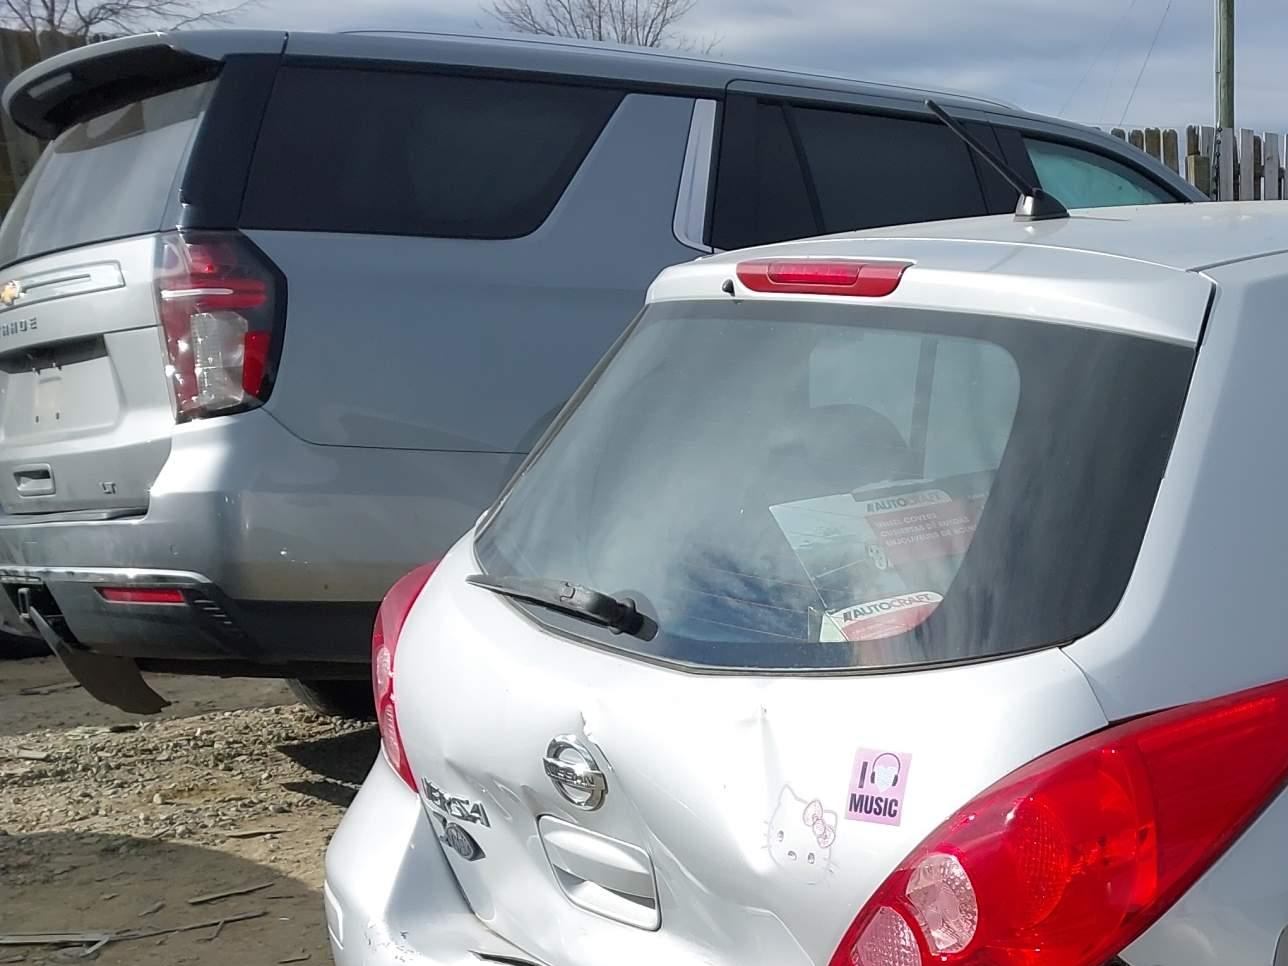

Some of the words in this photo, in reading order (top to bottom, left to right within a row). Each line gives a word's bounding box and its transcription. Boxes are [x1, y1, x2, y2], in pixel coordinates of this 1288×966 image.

[854, 593, 931, 619] AUTOCRAFT
[858, 761, 868, 788] I
[421, 777, 491, 828] VERSA
[849, 793, 898, 817] MUSIC
